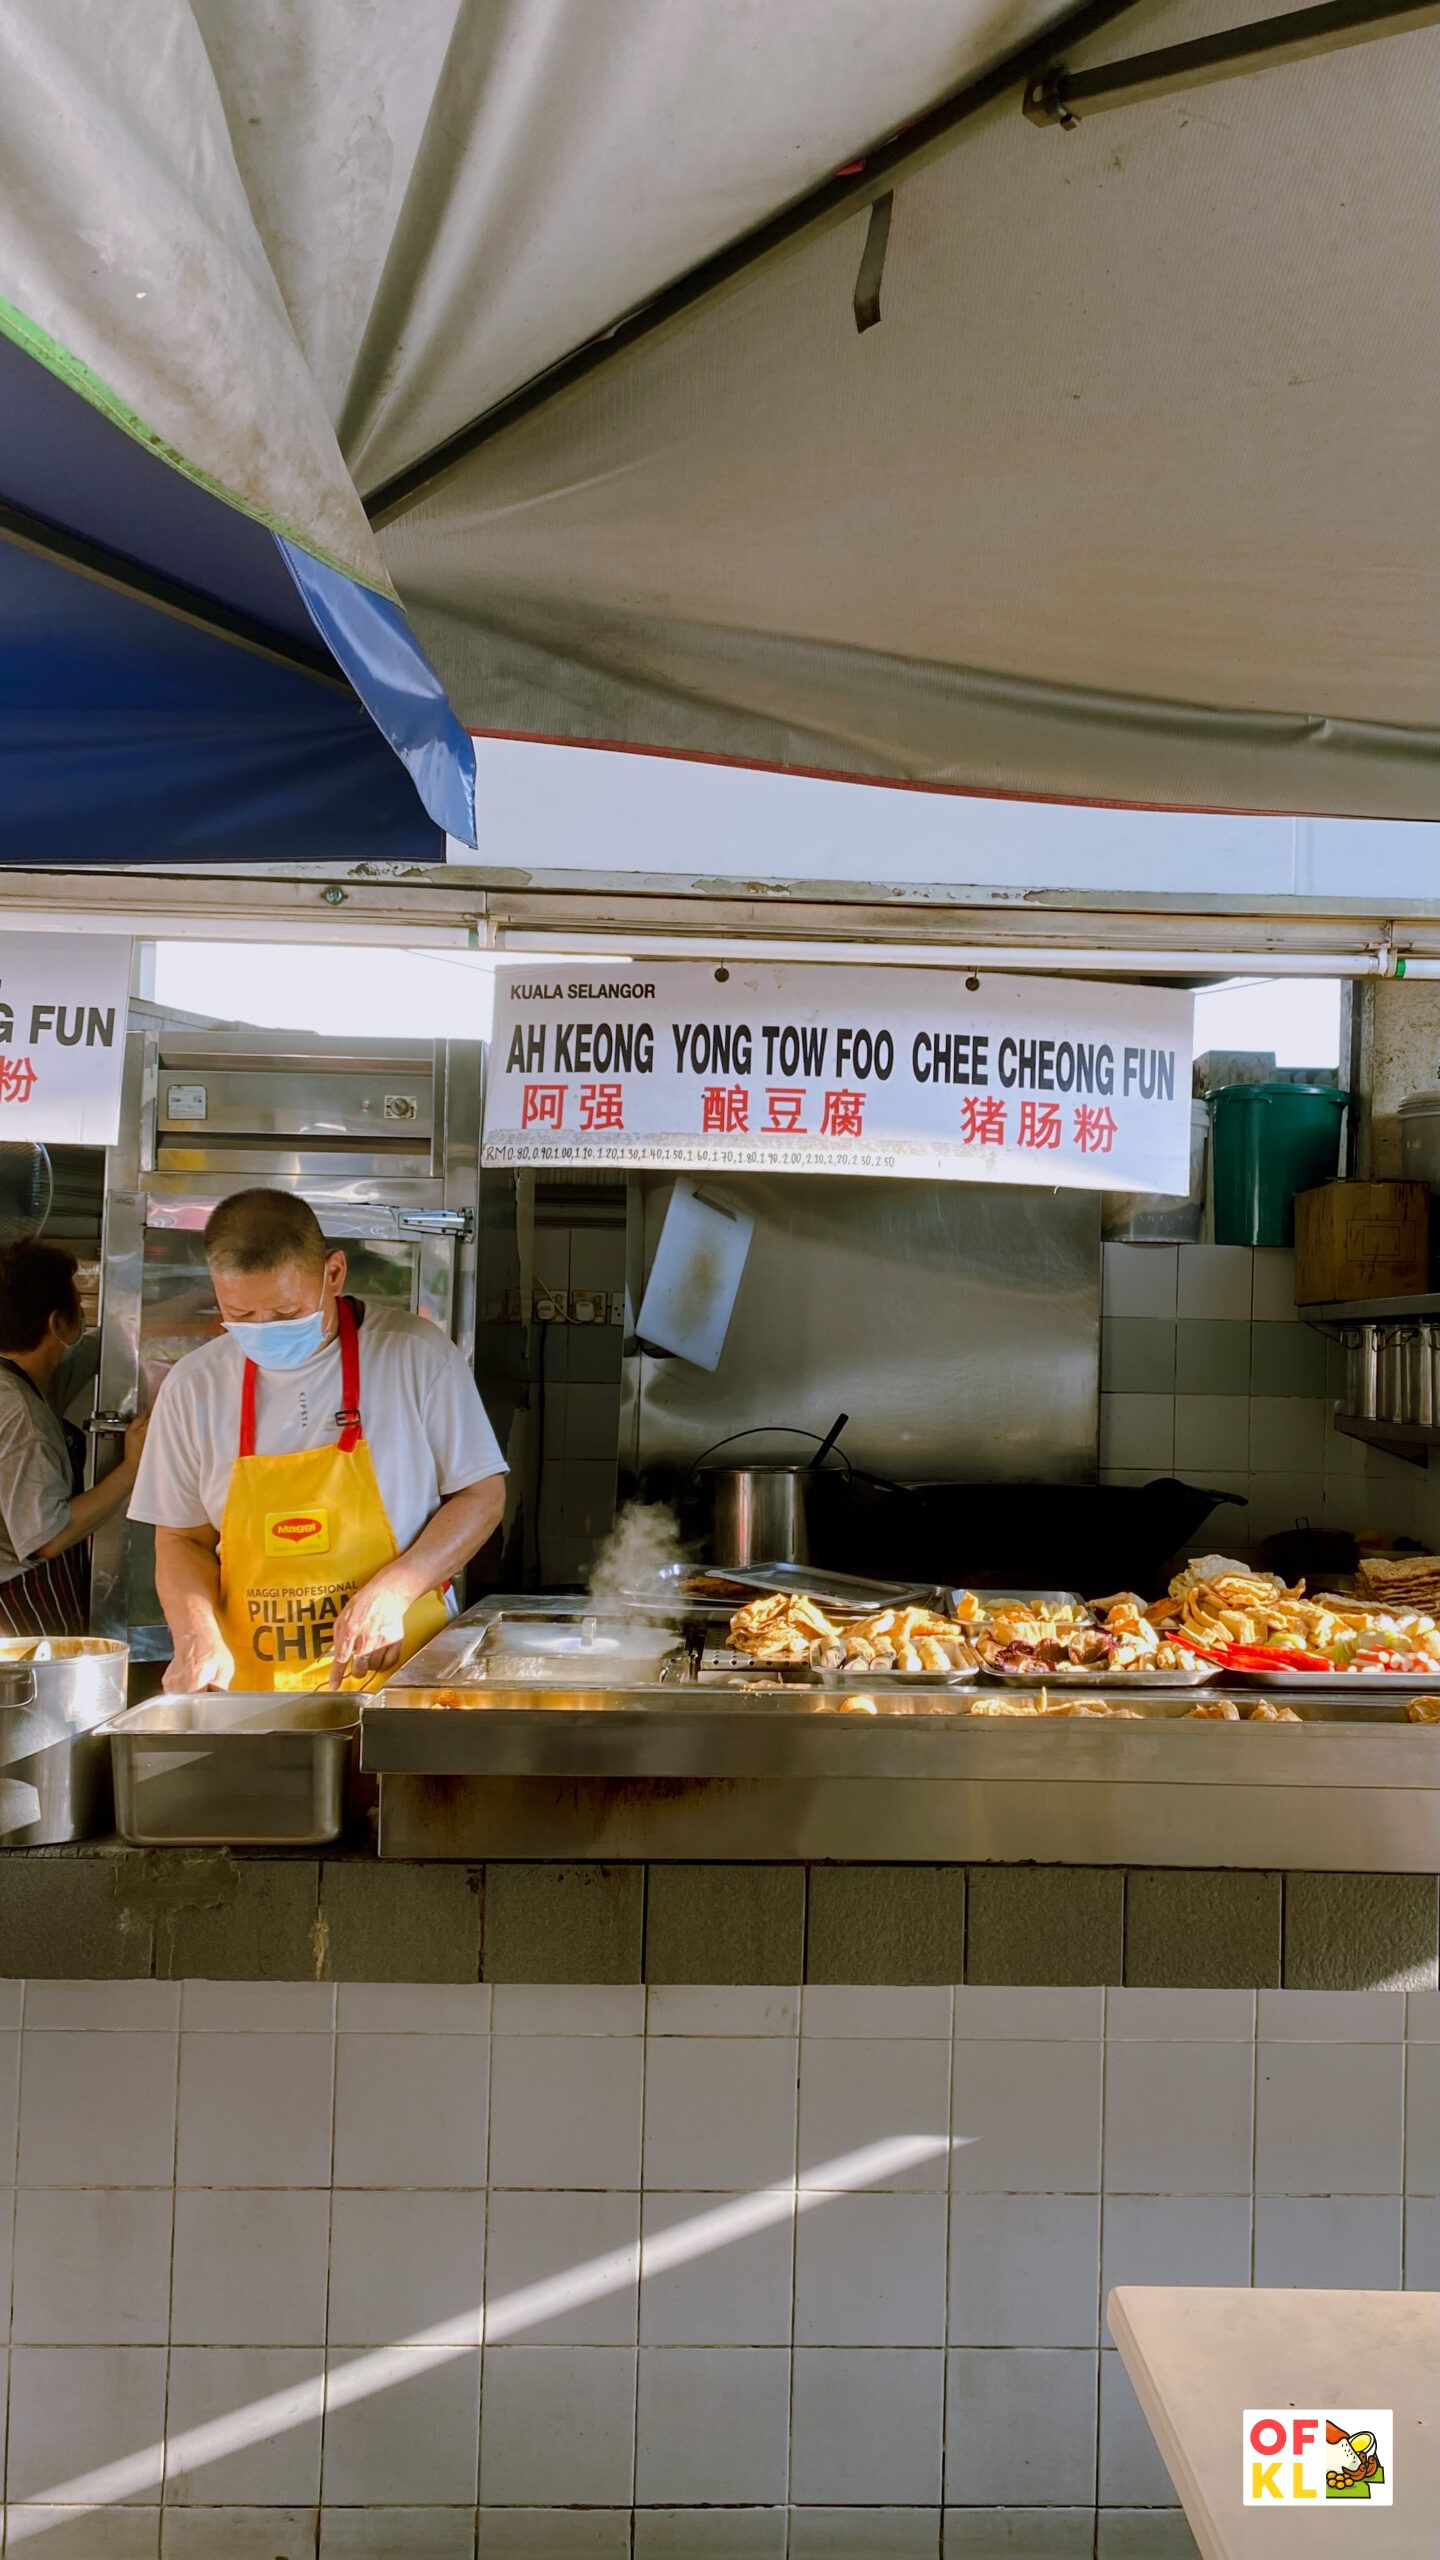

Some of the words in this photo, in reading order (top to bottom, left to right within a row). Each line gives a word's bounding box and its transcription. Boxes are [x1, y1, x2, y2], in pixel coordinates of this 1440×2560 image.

[511, 984, 563, 999] KUALA
[567, 983, 656, 999] SELANGOR
[29, 1005, 116, 1048] FUN
[506, 1024, 546, 1074] AH
[554, 1022, 654, 1074] KEONG
[672, 1023, 752, 1076] YONG
[762, 1025, 828, 1078] TOW
[836, 1028, 894, 1081] FOO
[912, 1031, 989, 1086] CHEE
[998, 1036, 1114, 1096] CHEONG
[1123, 1047, 1175, 1101] FUN
[521, 1083, 625, 1131] 阿强
[702, 1083, 867, 1138] 酿豆腐
[960, 1095, 1118, 1153] 猪肠粉
[246, 1588, 280, 1598] MAGGI
[281, 1580, 358, 1598] PROFESIONAL
